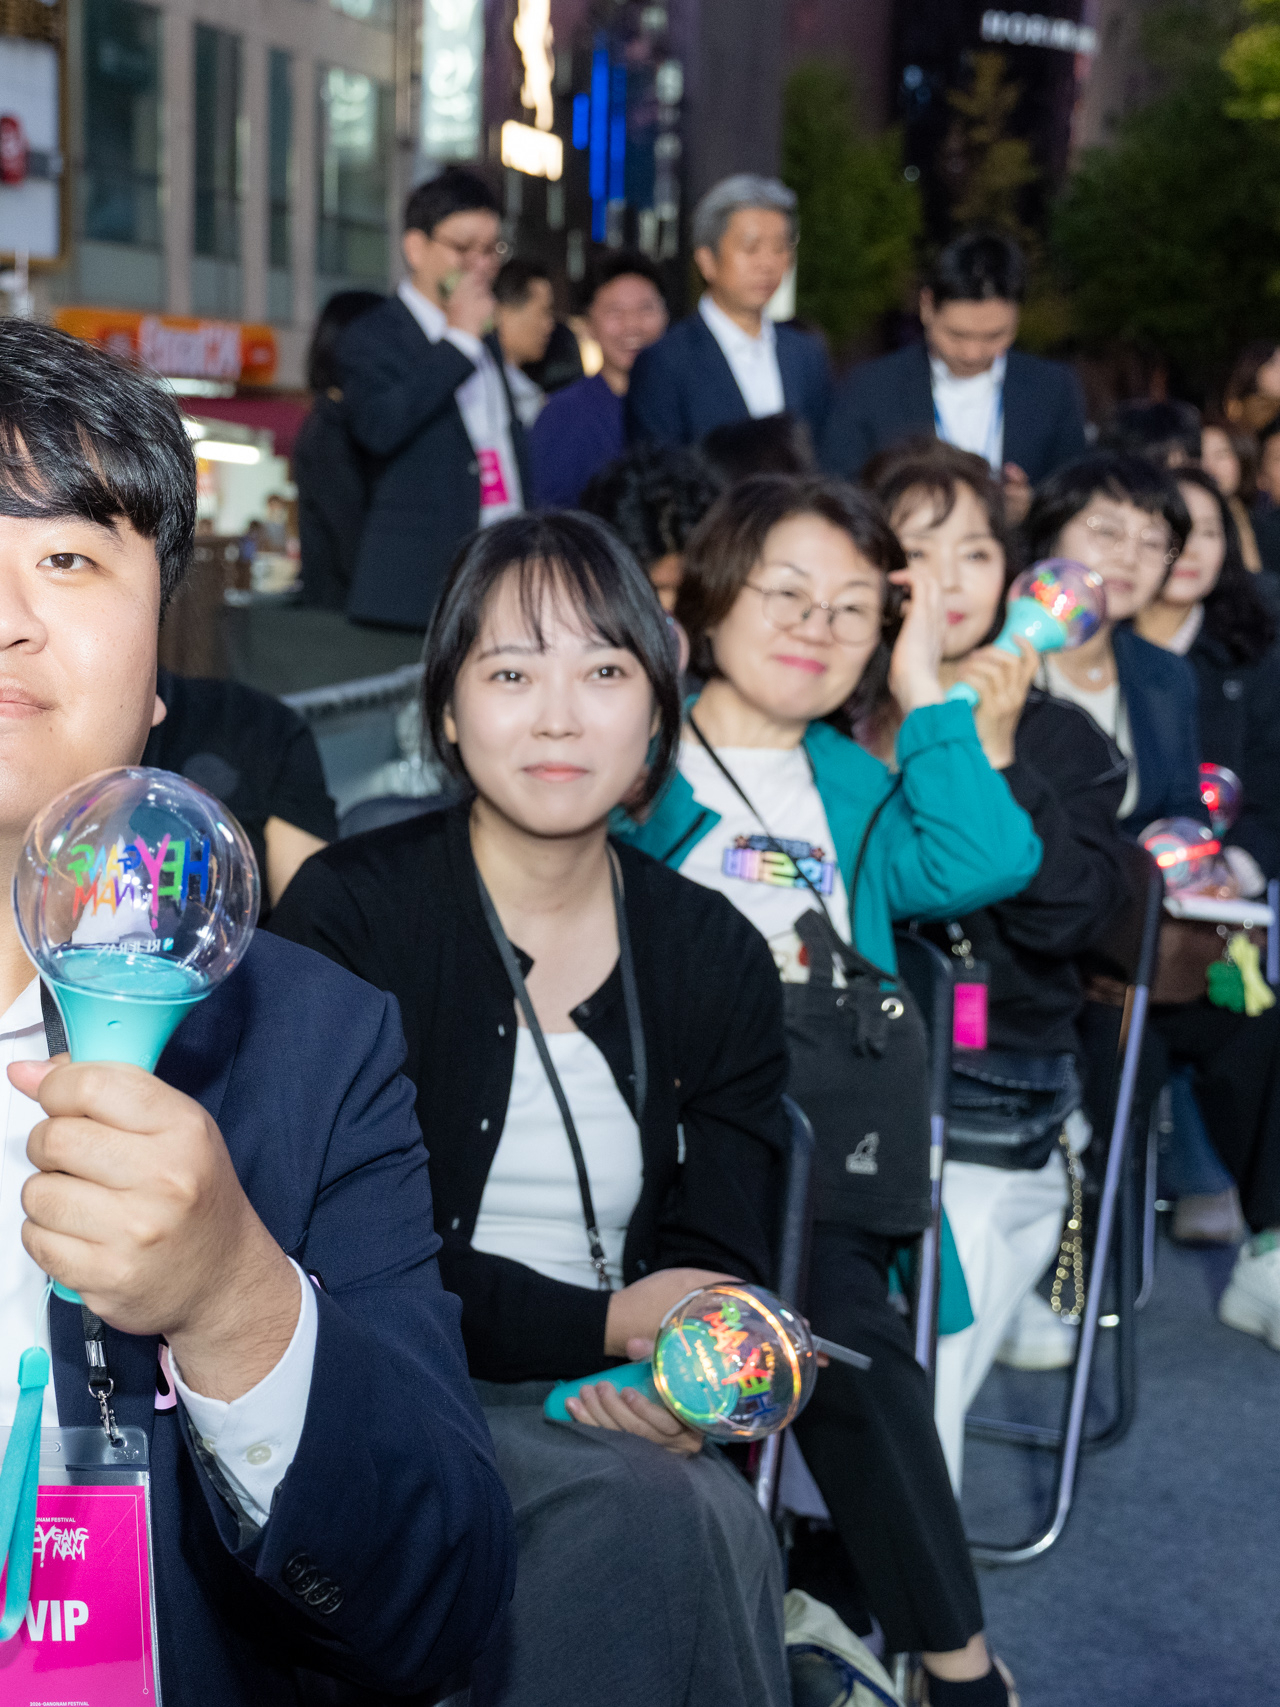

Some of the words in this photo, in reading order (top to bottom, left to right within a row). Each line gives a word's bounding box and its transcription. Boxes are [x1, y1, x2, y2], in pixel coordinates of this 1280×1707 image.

[33, 1524, 57, 1568] EY
[52, 1541, 86, 1562] NAM
[25, 1600, 90, 1642] VIP
